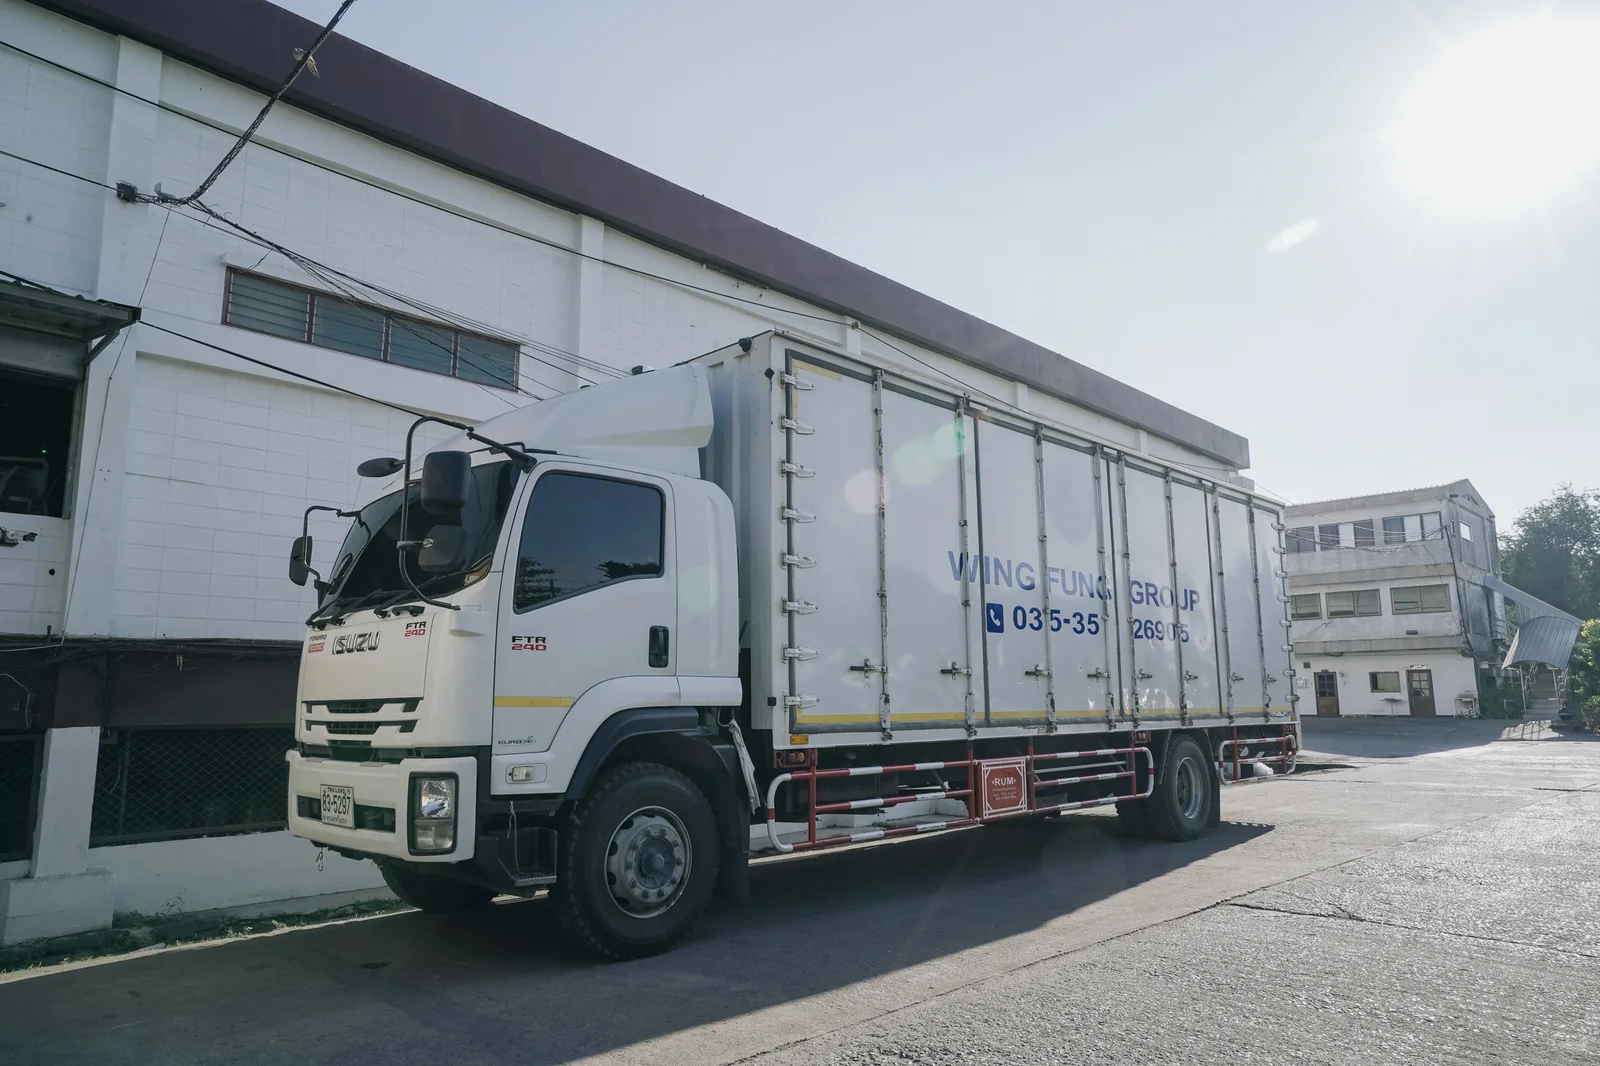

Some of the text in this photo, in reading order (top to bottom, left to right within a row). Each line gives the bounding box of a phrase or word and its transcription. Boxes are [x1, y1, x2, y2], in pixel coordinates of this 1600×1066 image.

[948, 551, 1035, 590] WING
[1131, 580, 1200, 611] GROUP
[406, 621, 426, 630] FTR
[1013, 606, 1100, 635] 035-35
[332, 631, 381, 655] ISUZU
[405, 629, 426, 637] 240
[994, 777, 1014, 786] RUM
[322, 793, 350, 815] 83-5297
